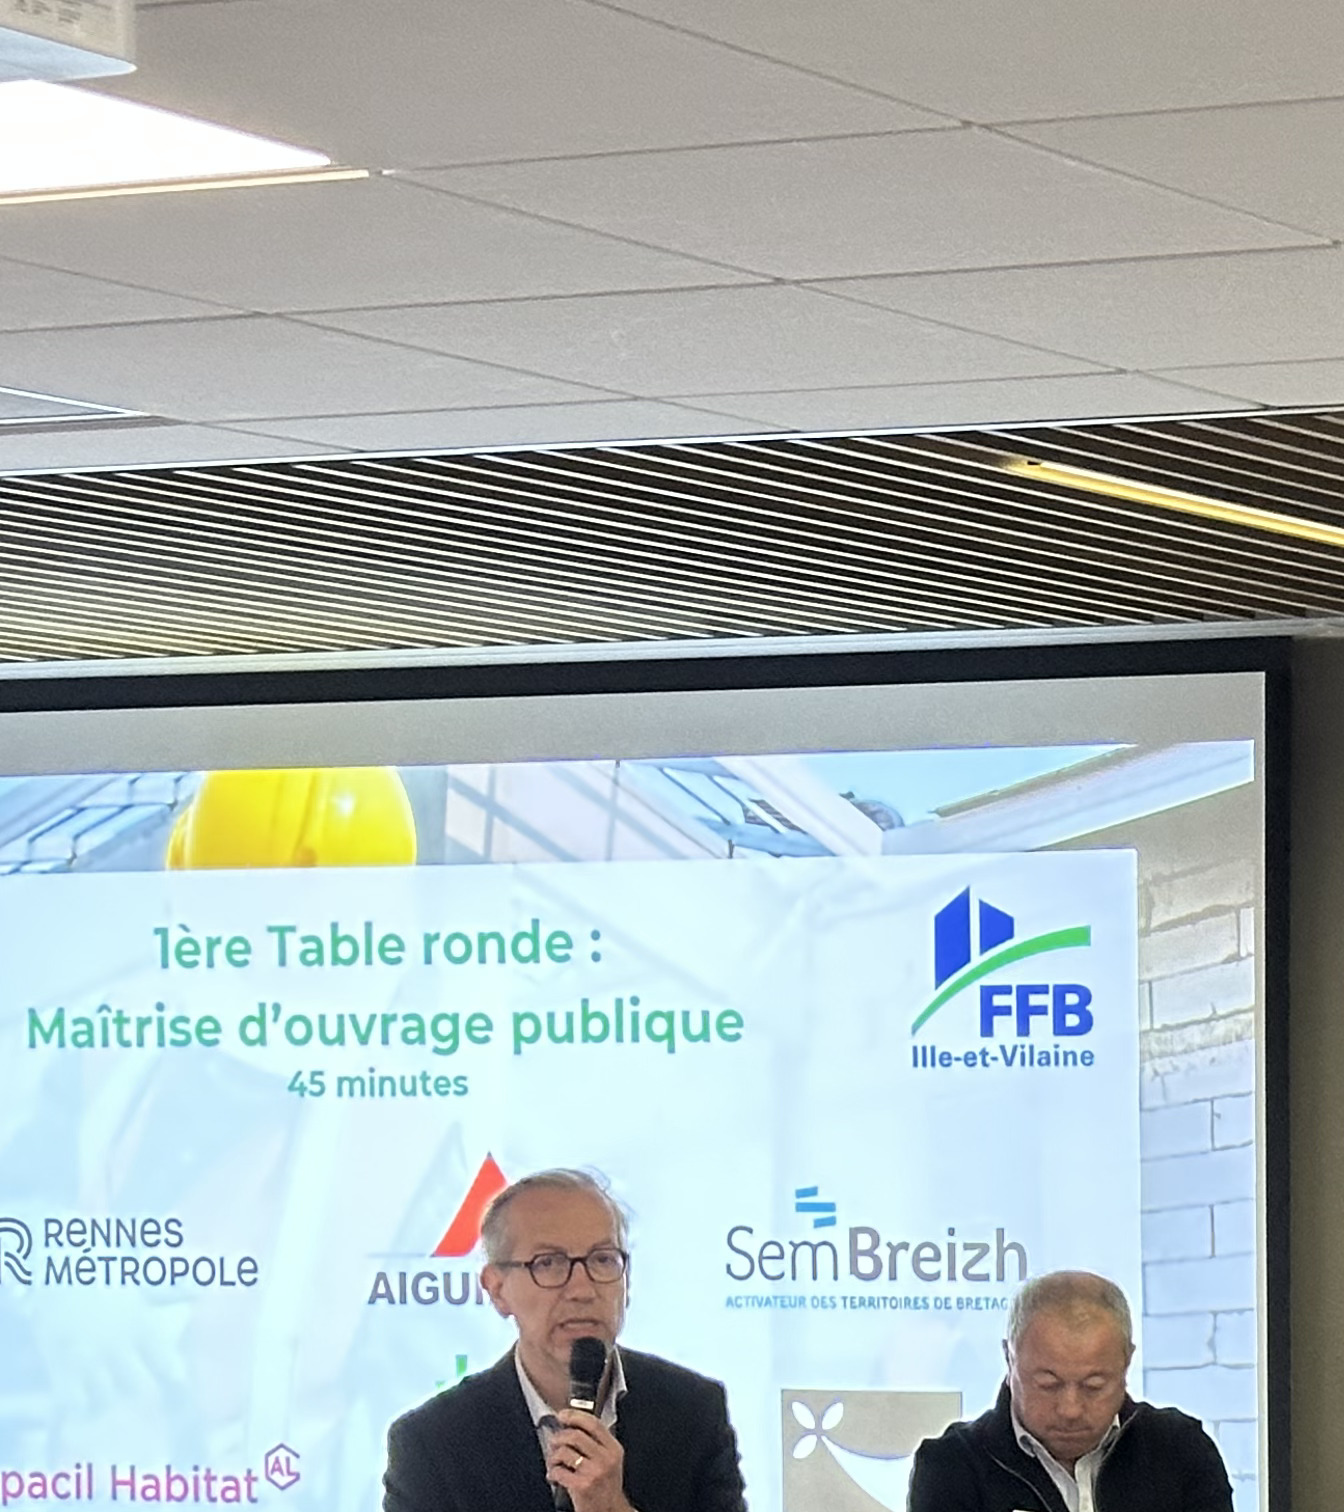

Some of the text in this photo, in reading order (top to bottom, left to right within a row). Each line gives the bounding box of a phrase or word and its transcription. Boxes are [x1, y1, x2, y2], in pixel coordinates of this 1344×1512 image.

[154, 923, 252, 969] 1ère
[267, 922, 406, 967] Table
[423, 919, 574, 964] ronde
[26, 1002, 223, 1048] Maîtrise
[512, 996, 744, 1055] publique
[979, 984, 1094, 1038] FFB
[911, 1044, 1095, 1068] Ille-et-Vilaine
[287, 1067, 469, 1097] 45 minutes
[367, 1271, 484, 1305] AIGUI
[725, 1295, 1009, 1311] ACTIVATEUR DES TERRITOIRES DE BRETAG
[111, 1465, 259, 1503] Habitat
